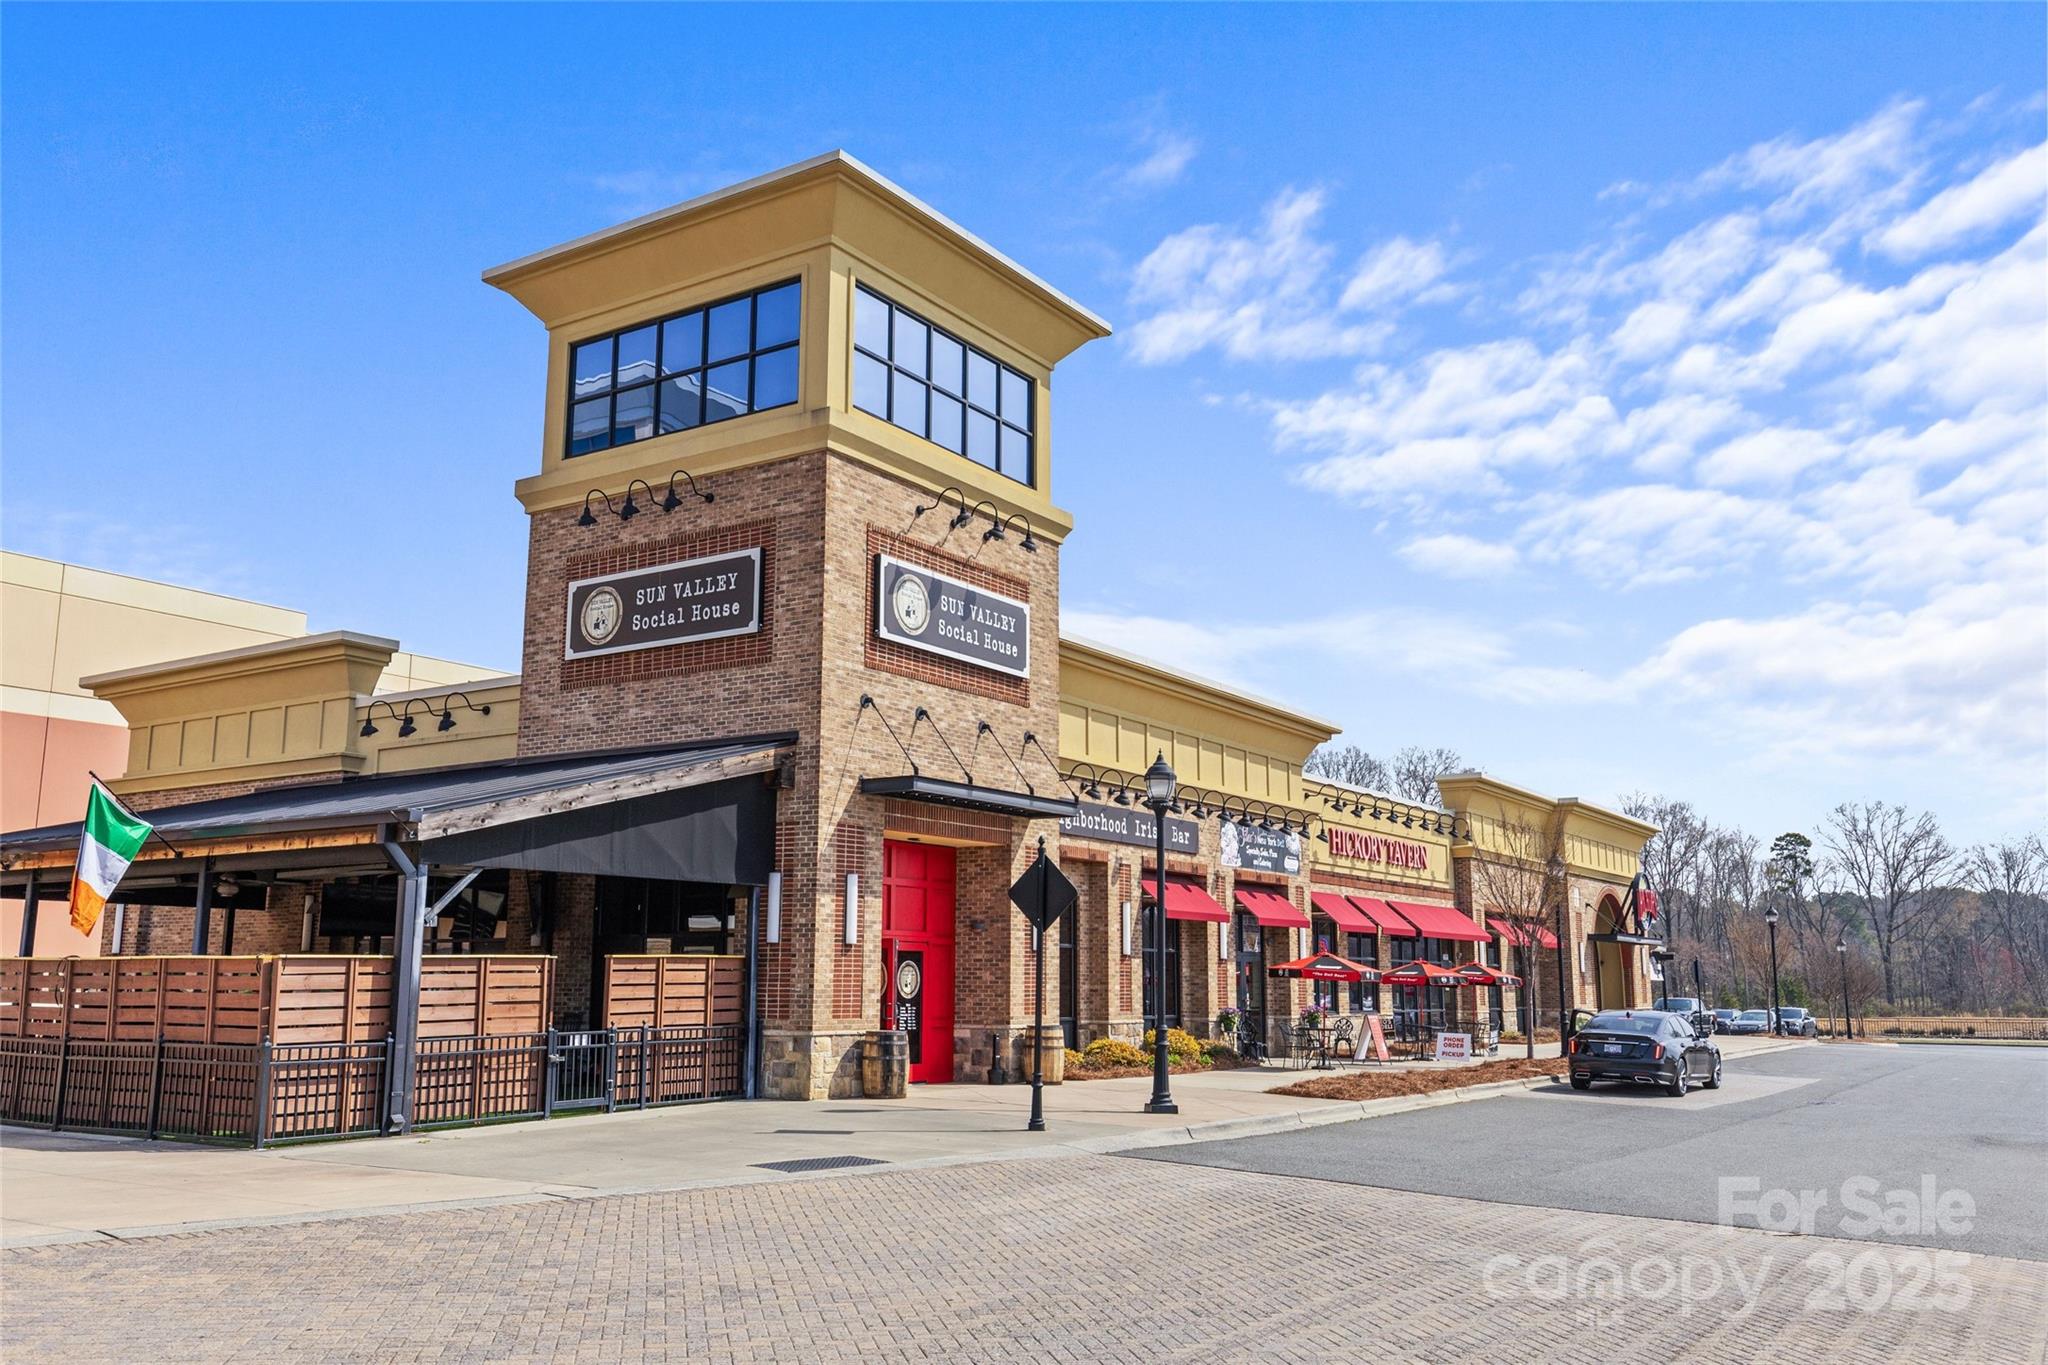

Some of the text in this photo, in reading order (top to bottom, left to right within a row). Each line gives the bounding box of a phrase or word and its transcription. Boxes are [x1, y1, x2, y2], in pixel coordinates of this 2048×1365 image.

[636, 572, 738, 605] SUN VALLEY
[632, 601, 740, 631] Social House
[941, 595, 1016, 633] SUN VALLEY
[938, 619, 1018, 657] Social House
[1135, 820, 1158, 839] Iris
[1171, 826, 1190, 845] Bar
[1328, 828, 1428, 869] HICKORY TAVERN
